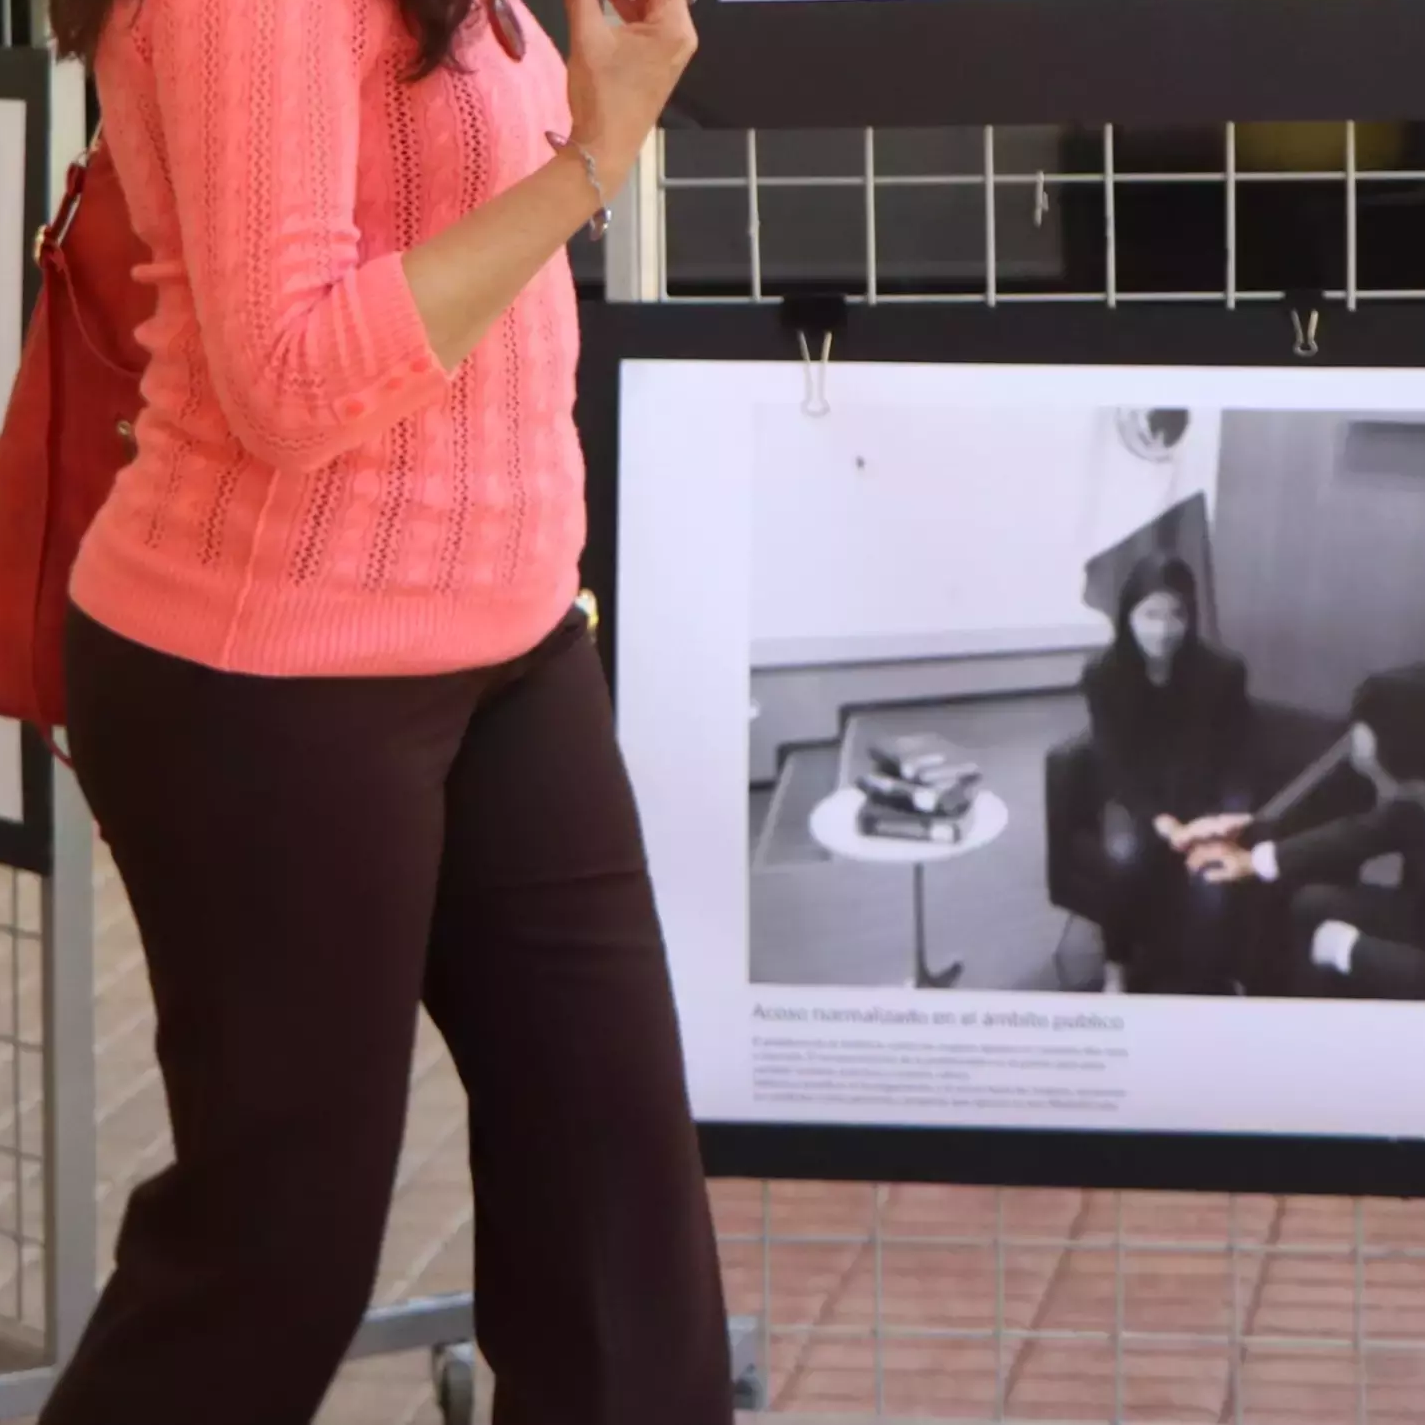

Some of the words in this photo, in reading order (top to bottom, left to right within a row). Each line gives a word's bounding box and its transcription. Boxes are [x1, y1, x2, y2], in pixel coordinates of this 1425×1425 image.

[751, 1003, 807, 1023] Acoso
[813, 1005, 929, 1025] normalizado
[933, 1010, 957, 1026] en
[961, 1008, 977, 1026] el
